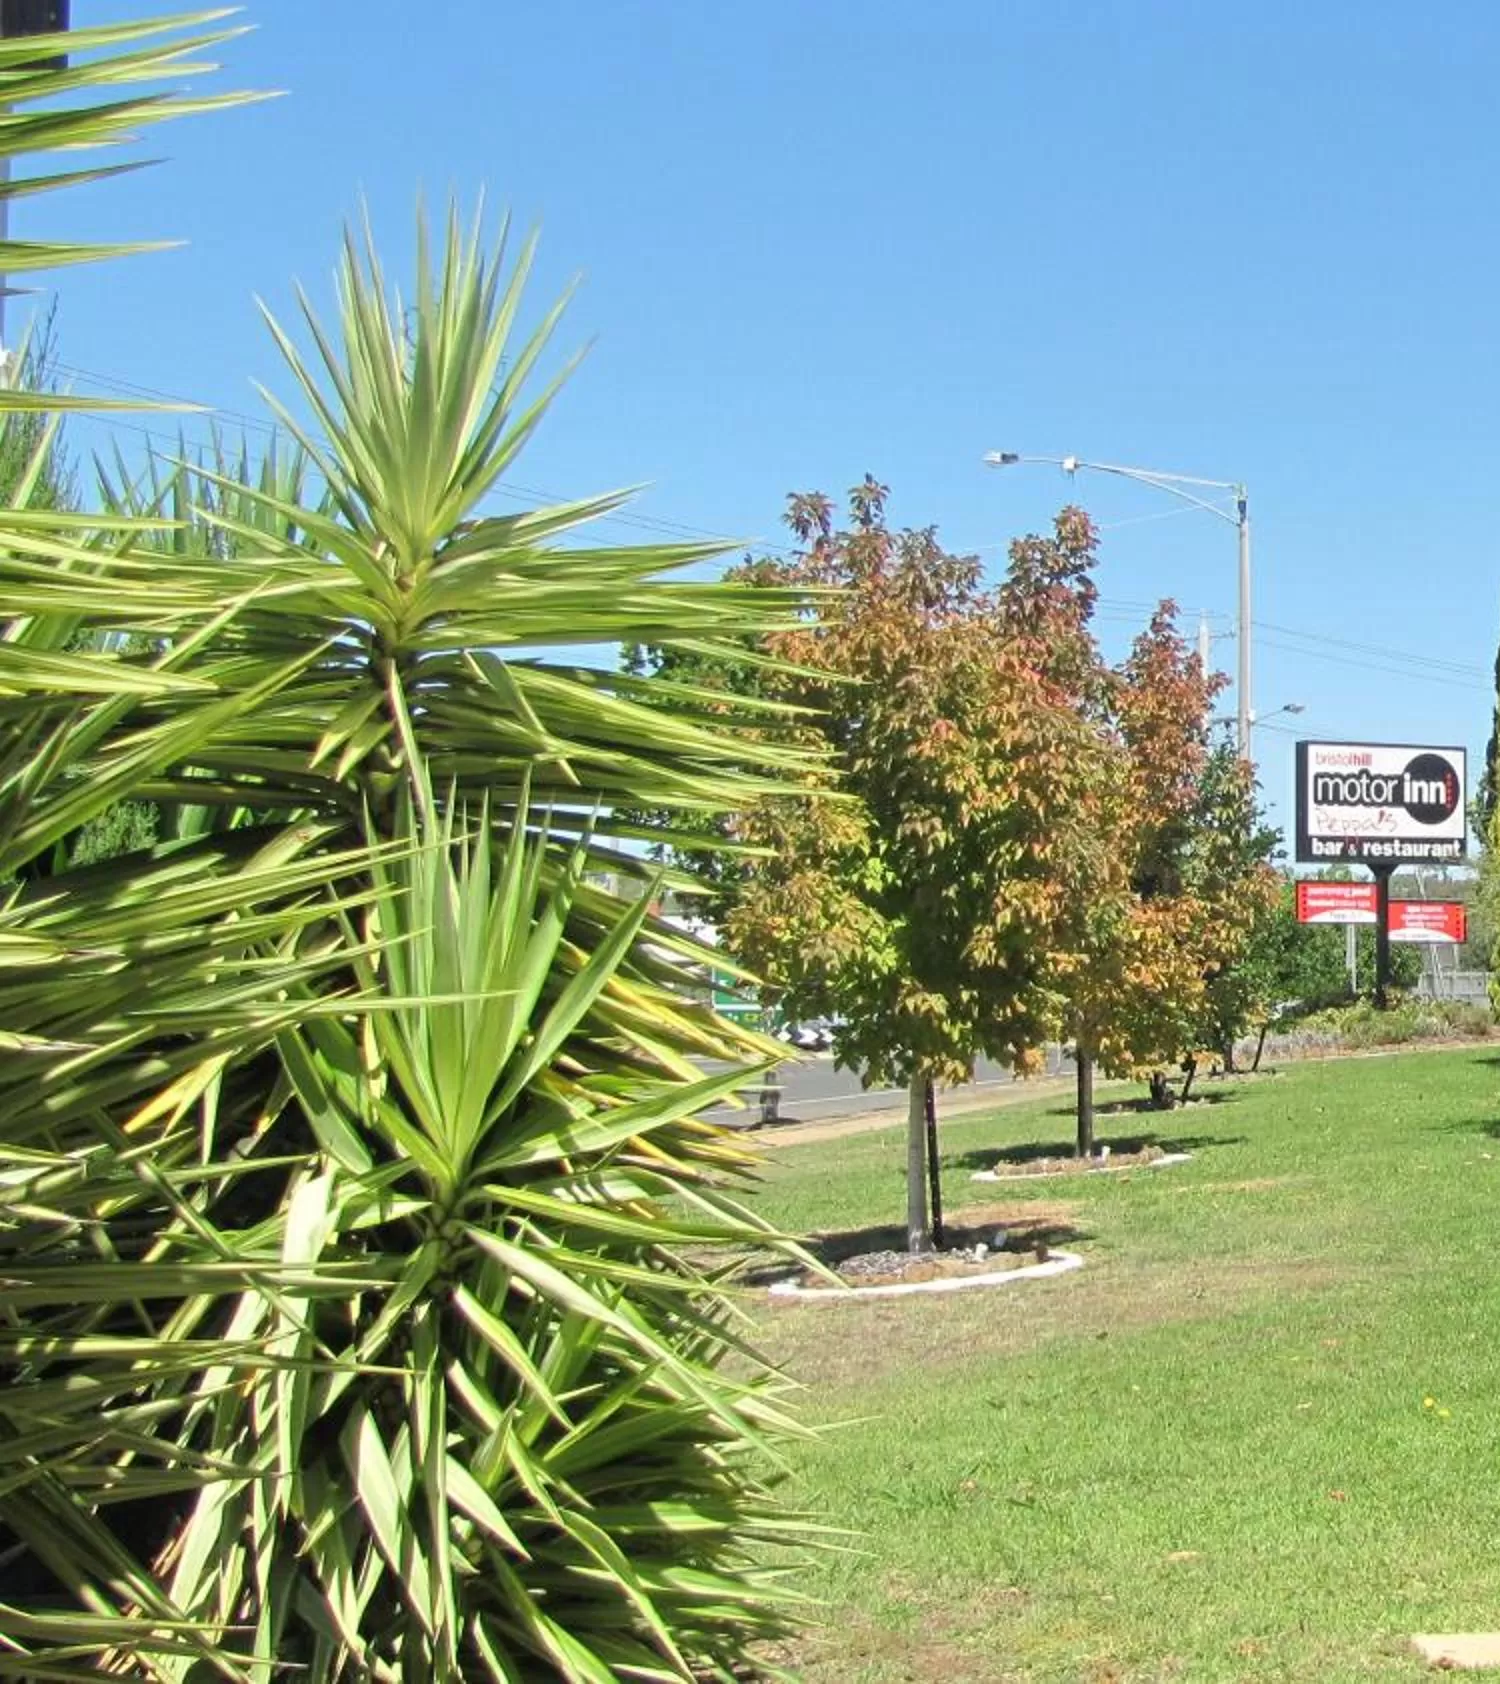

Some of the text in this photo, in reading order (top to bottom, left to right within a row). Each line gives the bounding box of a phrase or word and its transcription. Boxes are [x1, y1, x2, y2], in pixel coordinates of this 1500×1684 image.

[1317, 772, 1446, 805] motor inn
[1312, 838, 1344, 855] bar
[1363, 838, 1461, 858] restaurant
